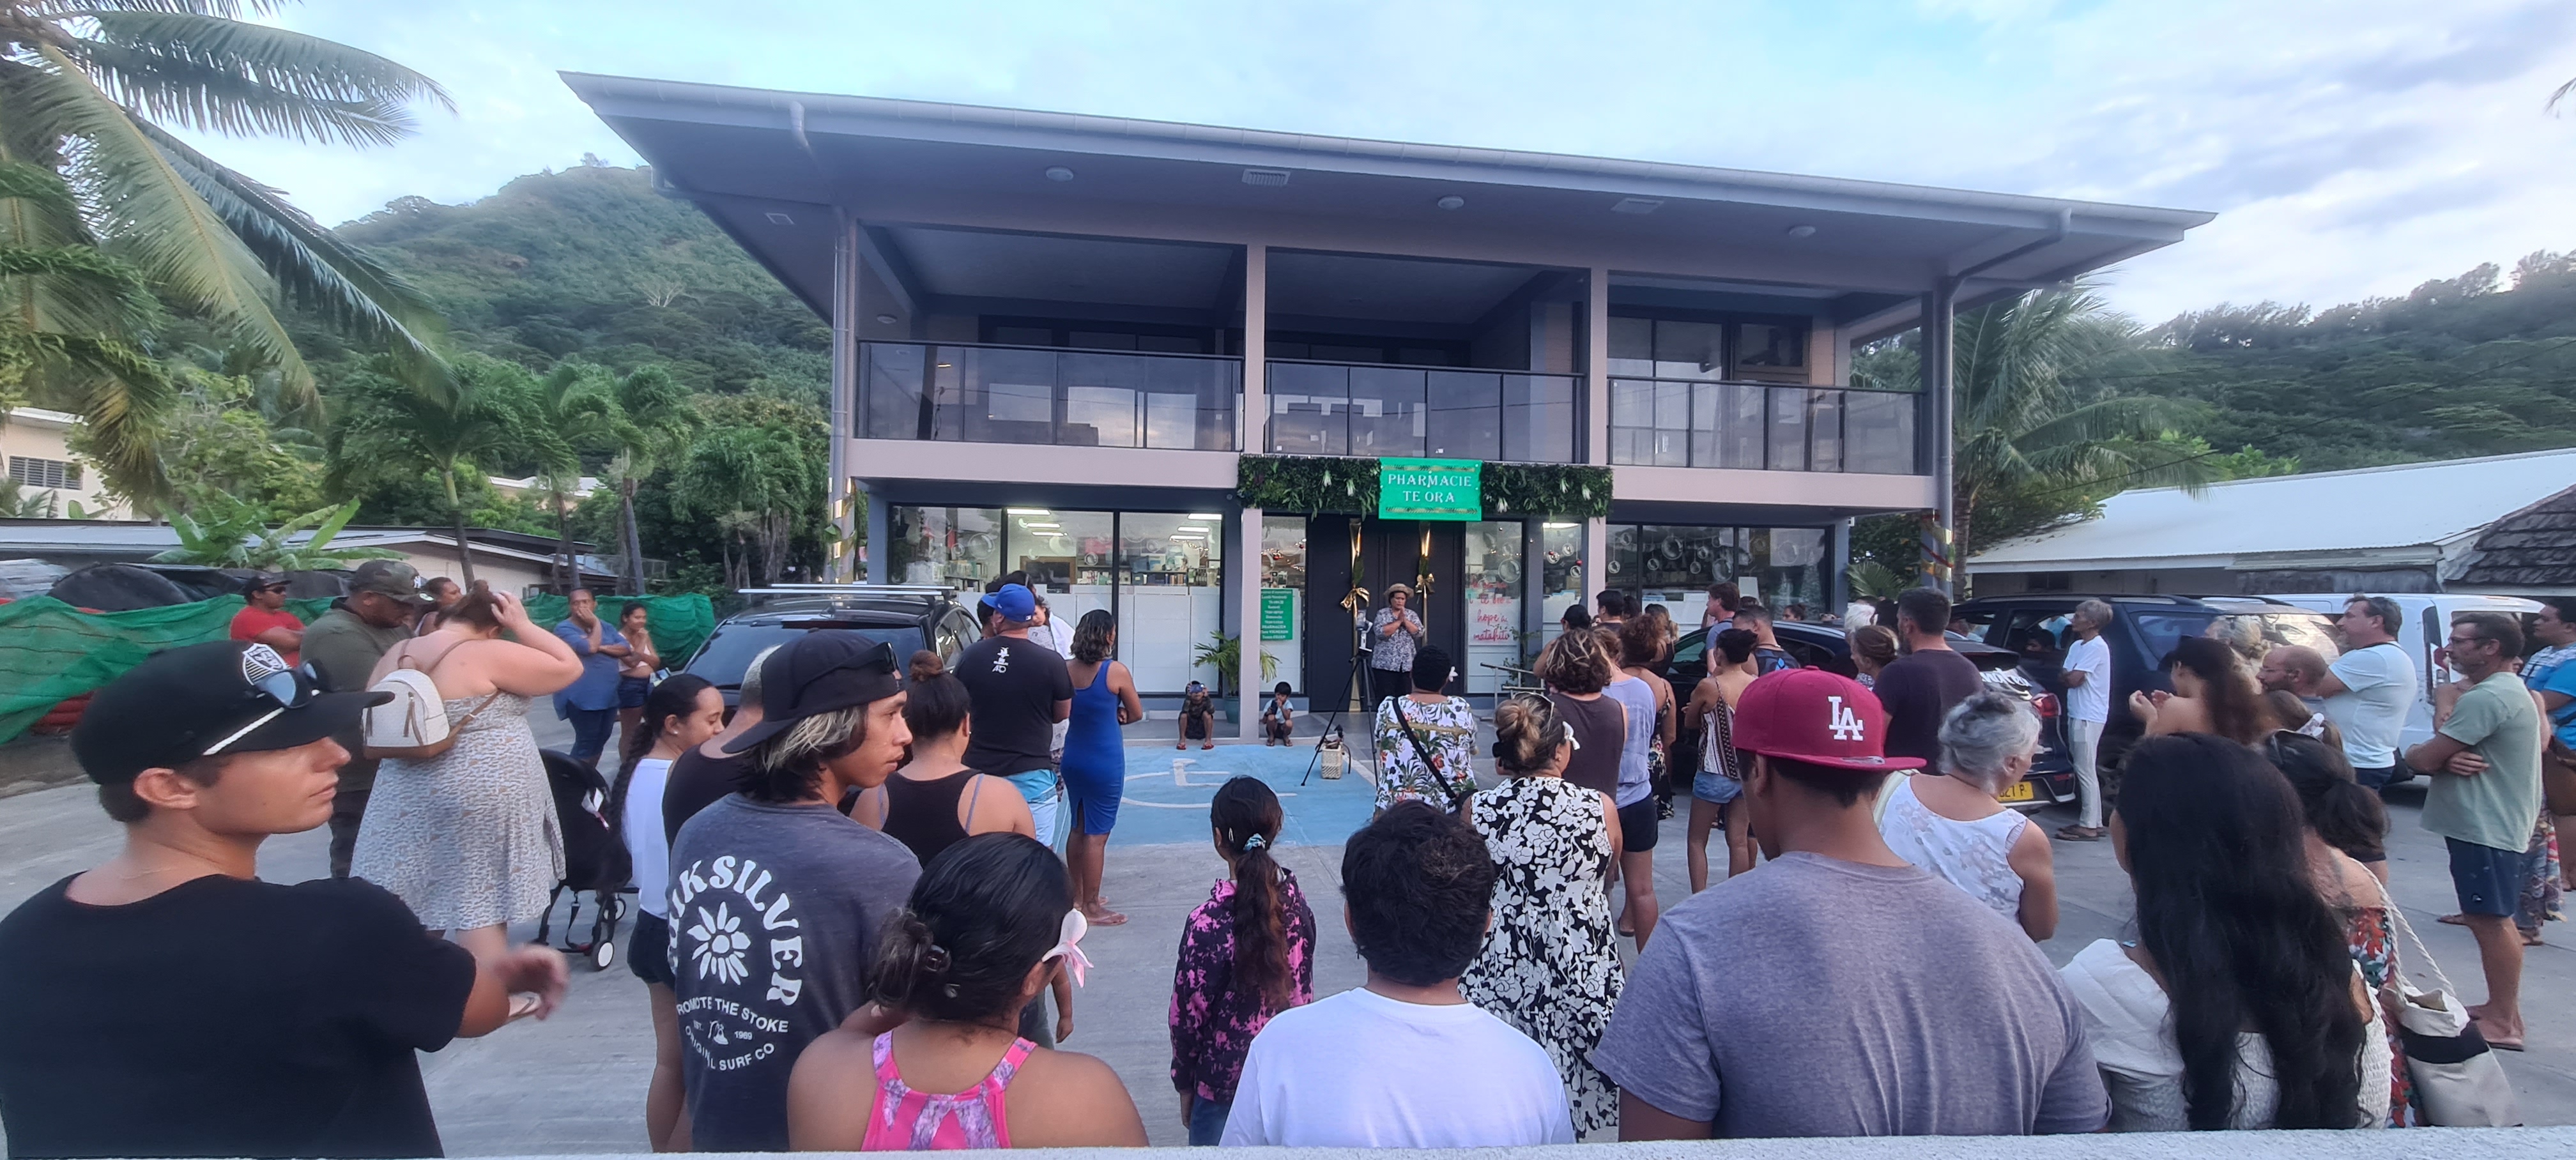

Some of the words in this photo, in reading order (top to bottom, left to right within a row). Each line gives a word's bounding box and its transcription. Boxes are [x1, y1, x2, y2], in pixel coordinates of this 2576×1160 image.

[1388, 473, 1472, 487] PHARMACIE
[1403, 491, 1421, 501] TE
[1425, 491, 1455, 503] ORA
[1828, 696, 1864, 741] LA
[2019, 784, 2025, 797] P
[676, 996, 712, 1016] ROMOTE
[715, 998, 740, 1016] THE
[741, 1007, 789, 1033] STOKE
[735, 1031, 753, 1040] 1969
[685, 1026, 716, 1070] ORIGINL
[719, 1053, 752, 1071] SURF
[755, 1043, 774, 1060] CO
